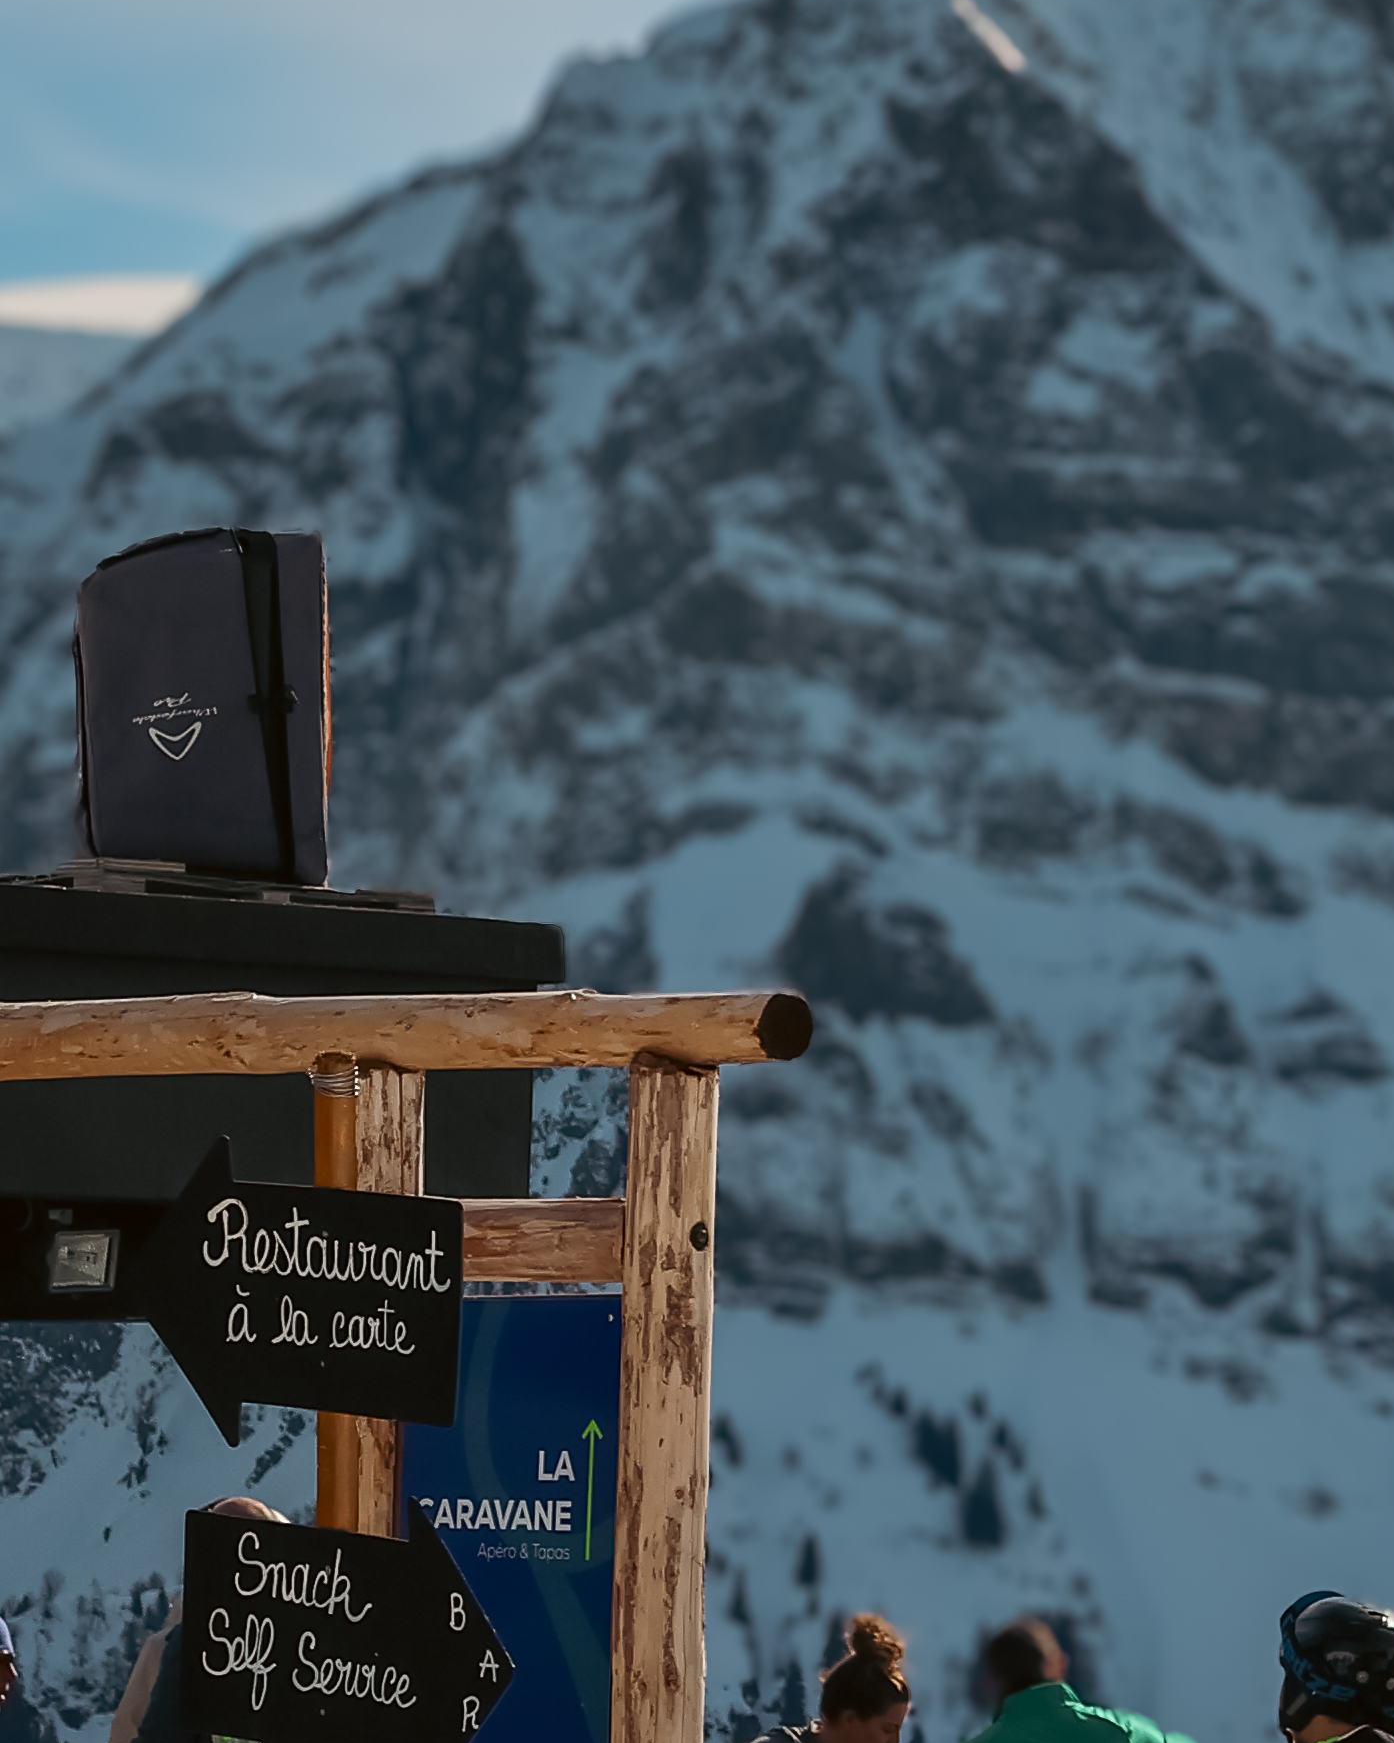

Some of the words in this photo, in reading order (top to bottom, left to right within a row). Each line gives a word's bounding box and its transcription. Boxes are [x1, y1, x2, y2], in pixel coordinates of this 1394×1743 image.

[203, 1198, 450, 1293] Restaurant
[271, 1295, 318, 1346] la
[329, 1299, 415, 1355] carte
[537, 1450, 576, 1482] LA
[234, 1531, 373, 1622] Snack
[477, 1542, 517, 1563] Apéro
[519, 1543, 529, 1560] &
[532, 1543, 571, 1564] Tapas
[202, 1608, 277, 1711] Self
[292, 1631, 417, 1708] Service
